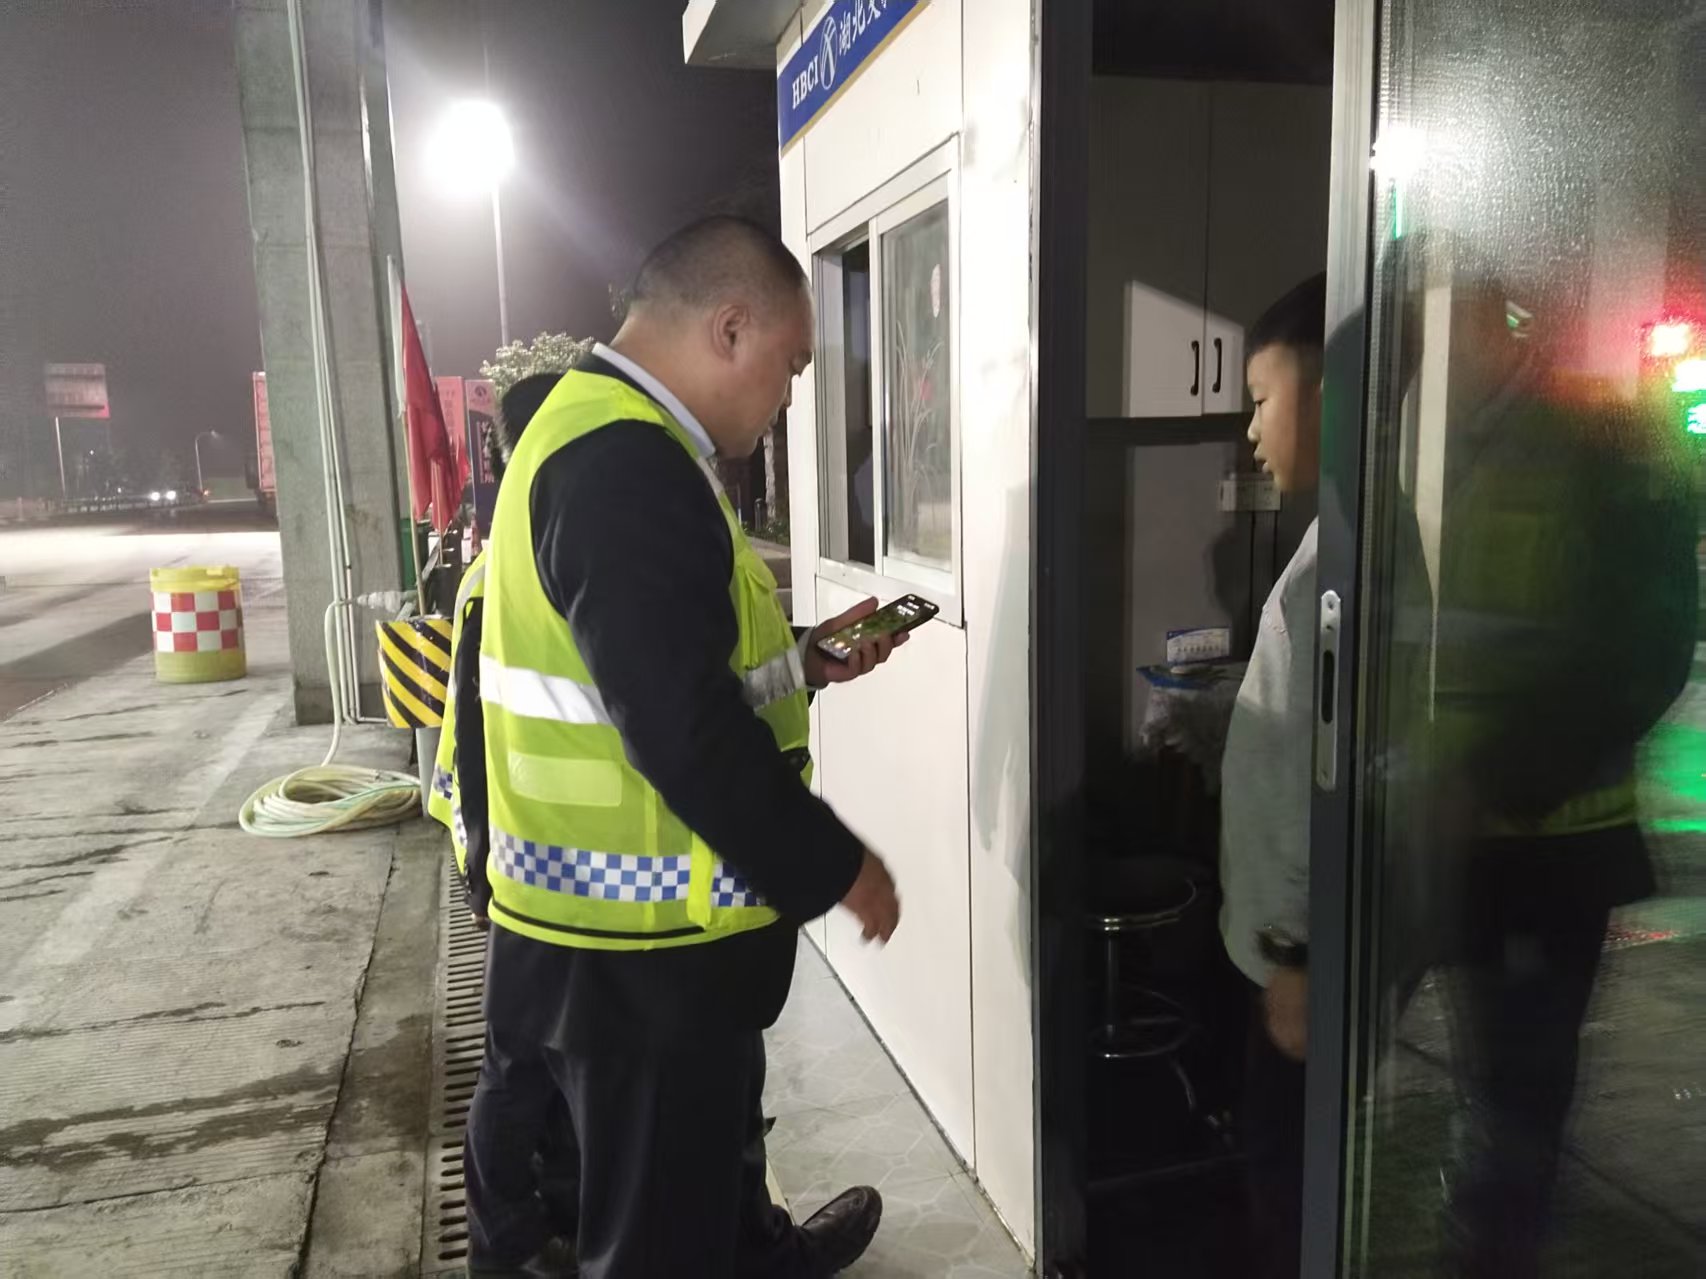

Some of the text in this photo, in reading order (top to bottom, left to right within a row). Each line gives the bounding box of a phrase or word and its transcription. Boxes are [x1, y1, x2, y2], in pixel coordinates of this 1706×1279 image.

[839, 0, 887, 56] 湖北交
[792, 54, 819, 110] HBCI
